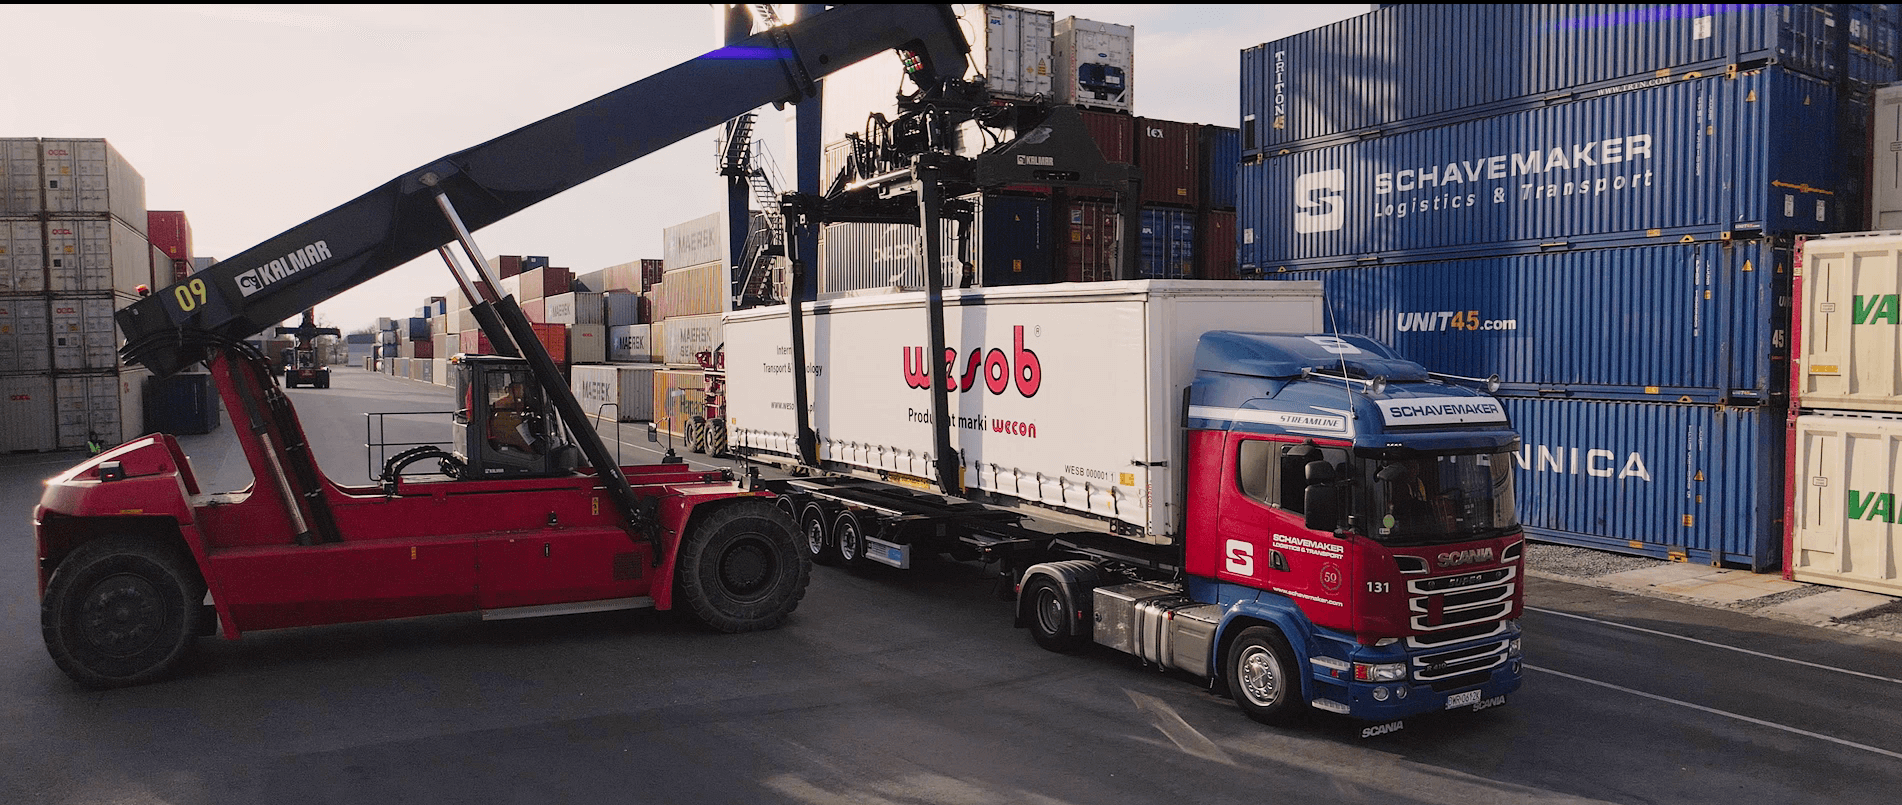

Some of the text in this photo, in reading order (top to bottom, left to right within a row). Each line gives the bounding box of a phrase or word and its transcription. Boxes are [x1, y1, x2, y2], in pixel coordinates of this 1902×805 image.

[1275, 50, 1285, 116] TRITON
[1596, 76, 1671, 96] WWW.TRTN.COM
[1146, 126, 1164, 139] tex
[1026, 156, 1054, 167] KALMAR
[1375, 133, 1652, 195] SCHAVEMAKER
[1374, 169, 1653, 218] Logistics & Transport
[678, 228, 716, 254] MAERSK
[258, 239, 333, 286] KALMAR
[174, 278, 207, 312] 09
[1851, 293, 1902, 325] VA
[1397, 310, 1517, 332] UNIT45.com
[619, 335, 645, 350] MAERSK
[680, 327, 712, 343] MAERSK
[1772, 329, 1785, 348] 45
[763, 362, 787, 376] Transport
[903, 325, 1041, 398] wesob
[1389, 403, 1499, 418] SCHAVEMAKER
[908, 407, 1037, 439] Produnt marki wecon
[1280, 415, 1340, 428] STREAMLINE
[1064, 464, 1085, 477] WESB
[1847, 489, 1902, 525] VA
[1272, 533, 1344, 554] SCHAVEMAKER
[1272, 541, 1301, 553] LOGISTICS
[1305, 547, 1344, 560] TRANSPORT
[1437, 547, 1494, 568] SCANIA
[1324, 571, 1337, 584] 50
[1366, 581, 1390, 593] 131
[1272, 586, 1344, 607] www.schavemaker.com
[1433, 662, 1447, 670] 410
[1472, 695, 1506, 712] SCANIA
[1361, 720, 1404, 739] SCANIA
